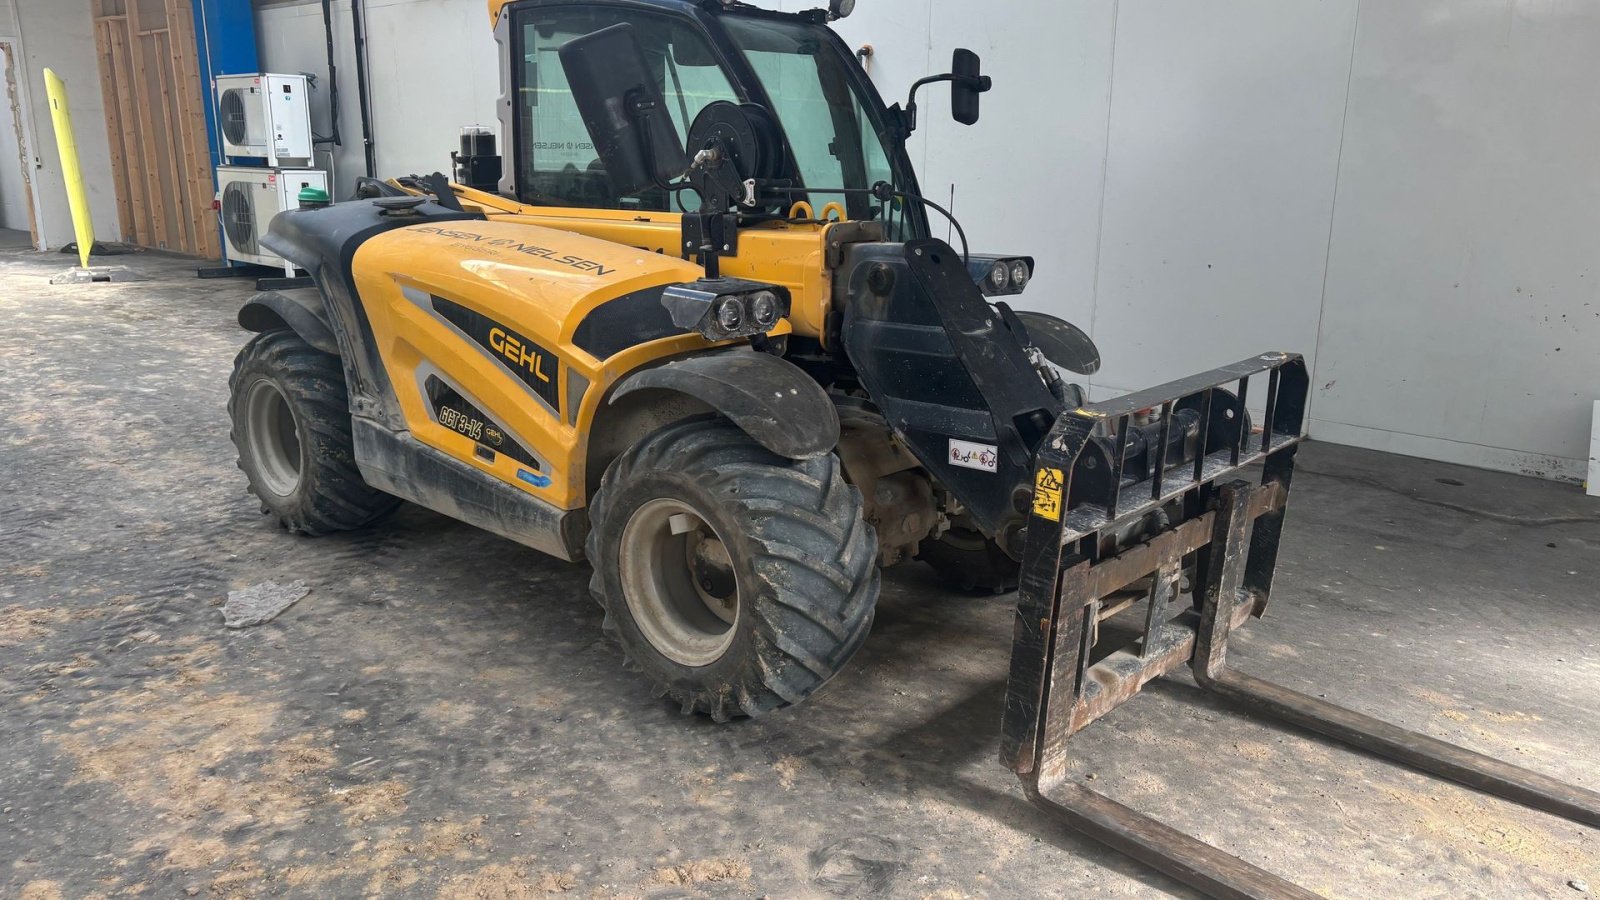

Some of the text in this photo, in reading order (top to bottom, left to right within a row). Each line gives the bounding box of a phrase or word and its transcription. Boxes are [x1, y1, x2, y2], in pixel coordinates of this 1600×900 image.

[407, 226, 489, 242] JENSEN
[511, 242, 616, 276] NIELSEN
[489, 327, 550, 383] GEHL
[458, 414, 484, 440] 3-14
[485, 427, 503, 440] GEHL
